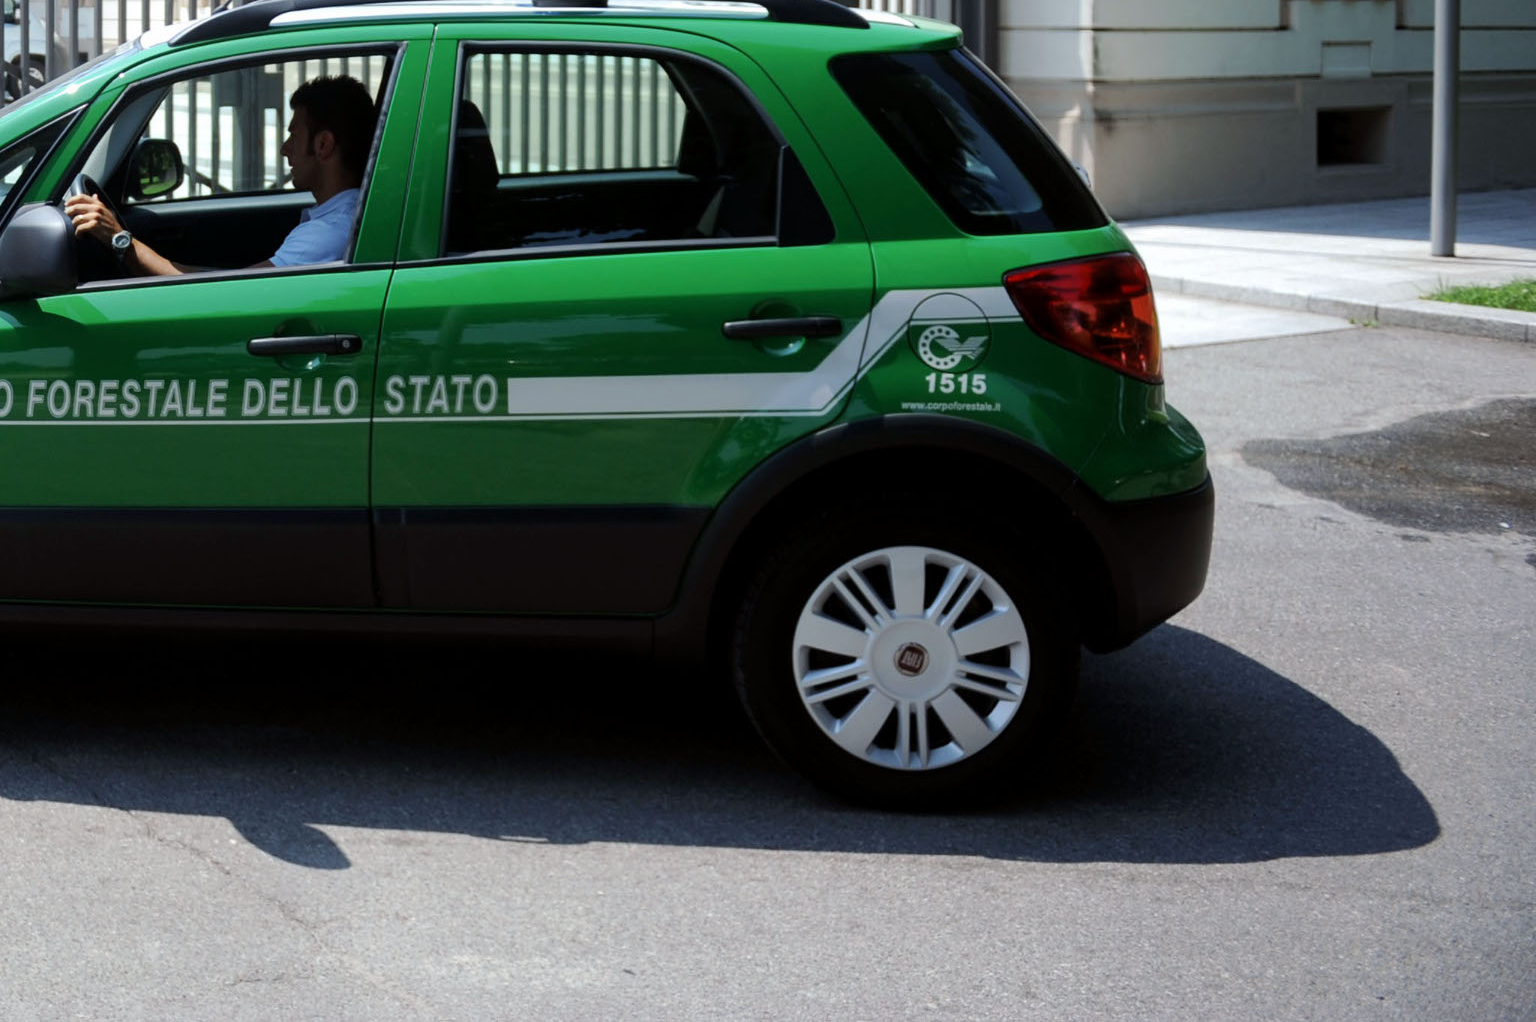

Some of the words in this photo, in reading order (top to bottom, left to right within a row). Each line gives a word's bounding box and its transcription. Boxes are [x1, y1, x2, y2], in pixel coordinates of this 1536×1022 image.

[925, 372, 988, 395] 1515
[26, 377, 229, 418] FORESTALE
[241, 376, 360, 416] DELLO
[383, 374, 499, 415] STATO
[900, 400, 1001, 412] www.corpoforestale.it
